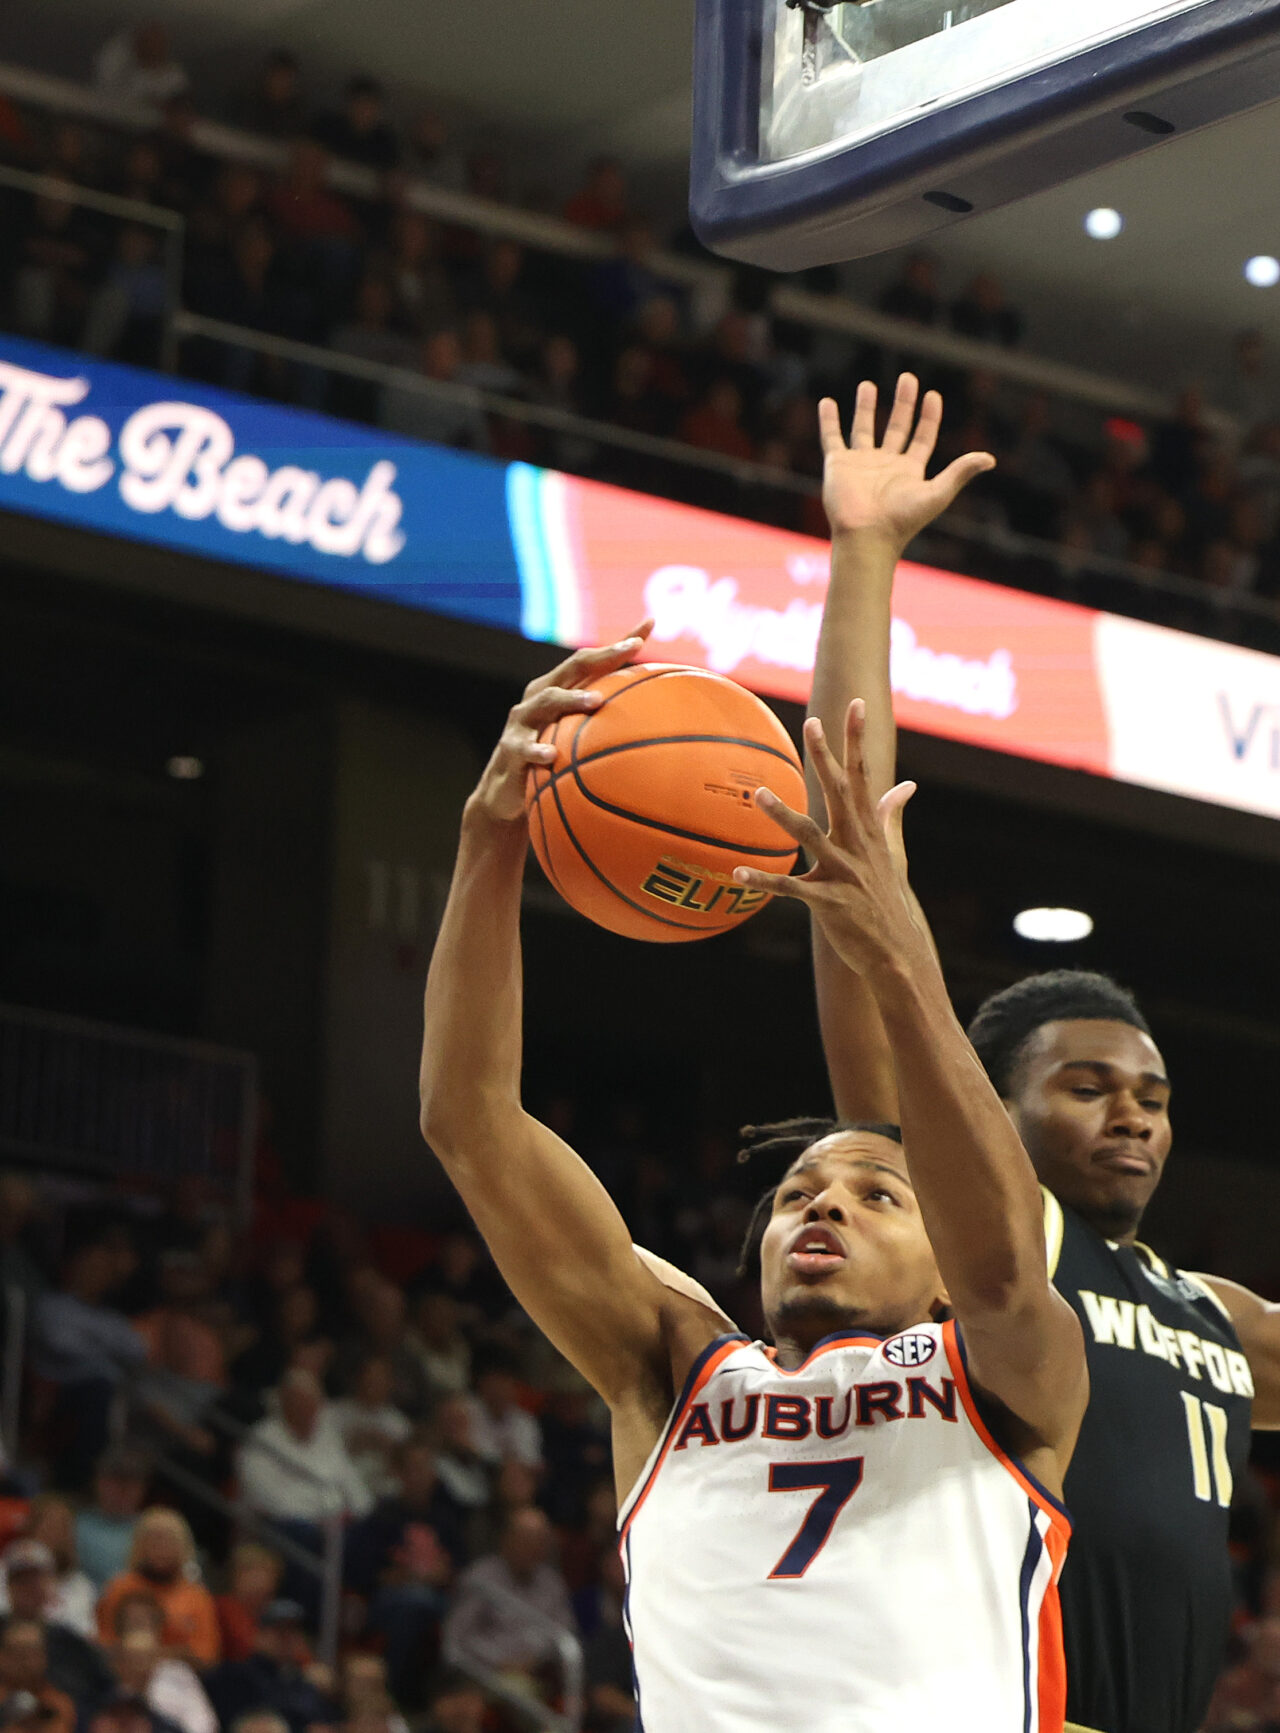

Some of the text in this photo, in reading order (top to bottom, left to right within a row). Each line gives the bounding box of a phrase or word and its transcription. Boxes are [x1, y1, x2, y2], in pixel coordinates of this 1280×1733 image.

[0, 360, 405, 563] The Beach
[640, 862, 769, 915] ELITE
[885, 1334, 934, 1366] SEC
[674, 1376, 958, 1451] AUBURN
[1180, 1390, 1233, 1508] 11
[767, 1456, 864, 1579] 7
